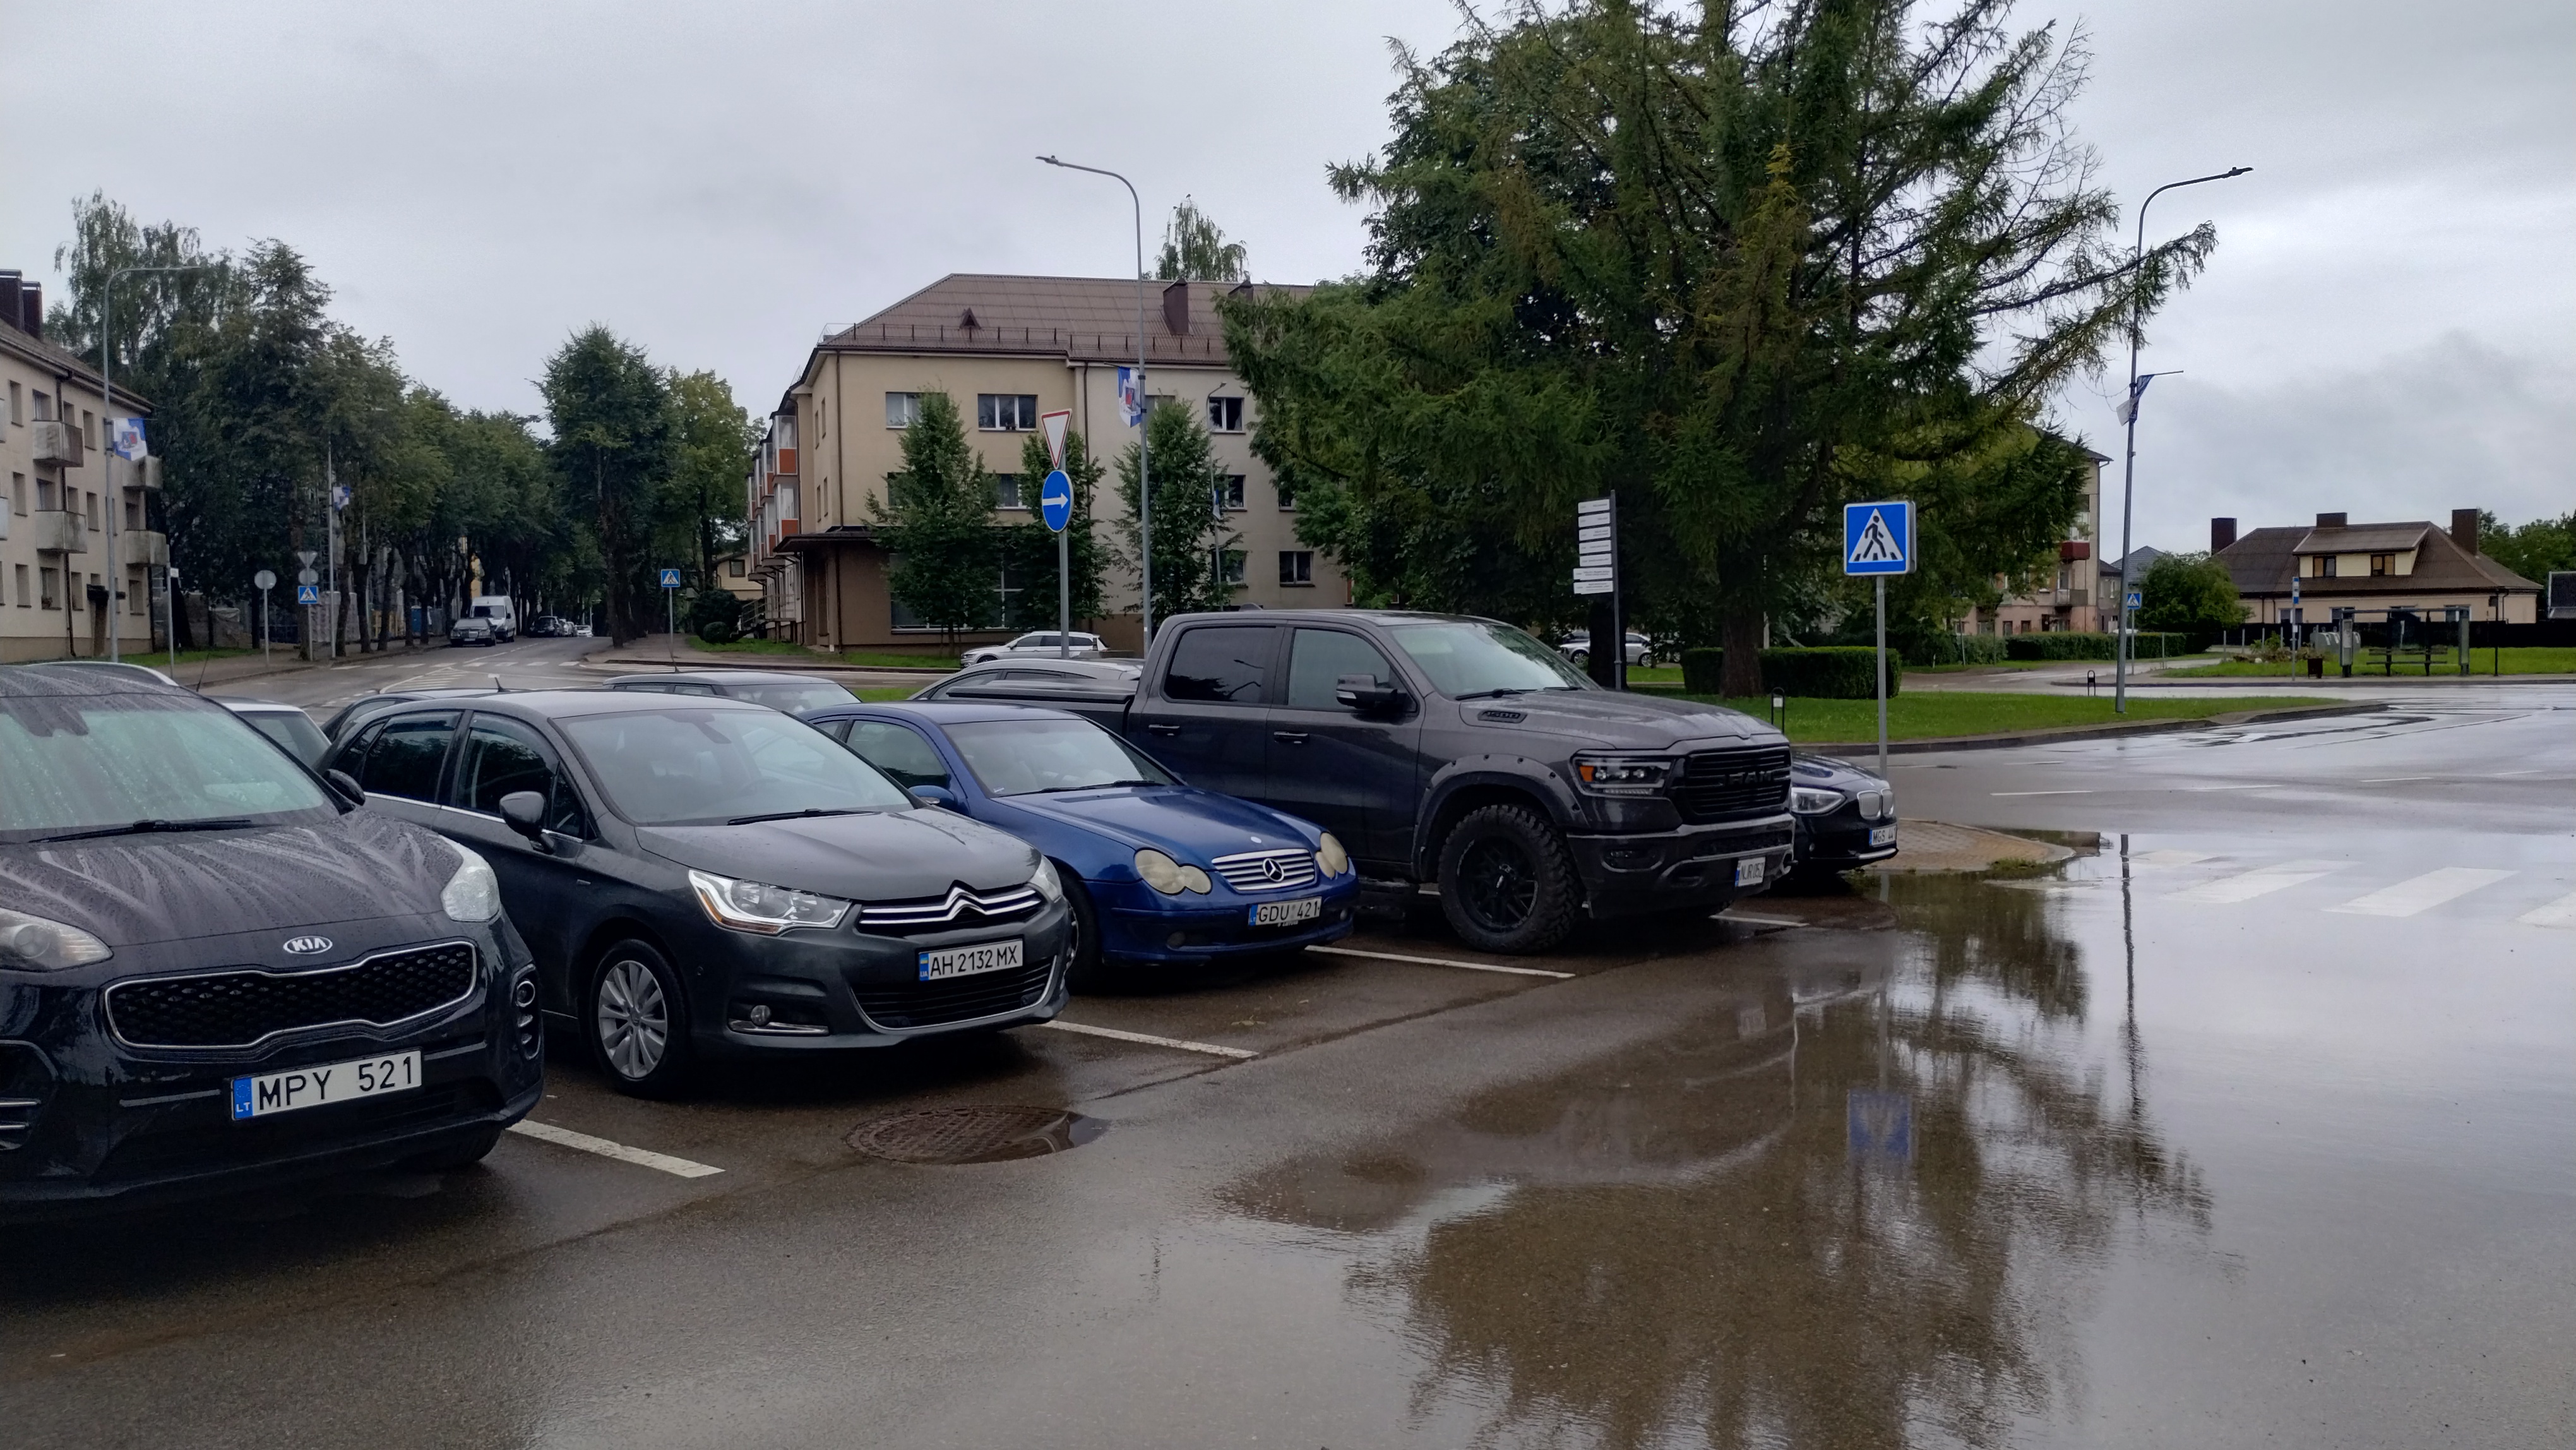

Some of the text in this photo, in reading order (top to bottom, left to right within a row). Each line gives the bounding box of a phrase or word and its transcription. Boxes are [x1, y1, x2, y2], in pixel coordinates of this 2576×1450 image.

[1729, 770, 1772, 784] RAM
[1873, 830, 1885, 843] MGS
[1259, 901, 1318, 922] GDU 421
[292, 938, 327, 951] KIA
[931, 945, 1018, 976] AH 2132 MX
[259, 1056, 412, 1110] MPY 521
[236, 1102, 251, 1113] LT
